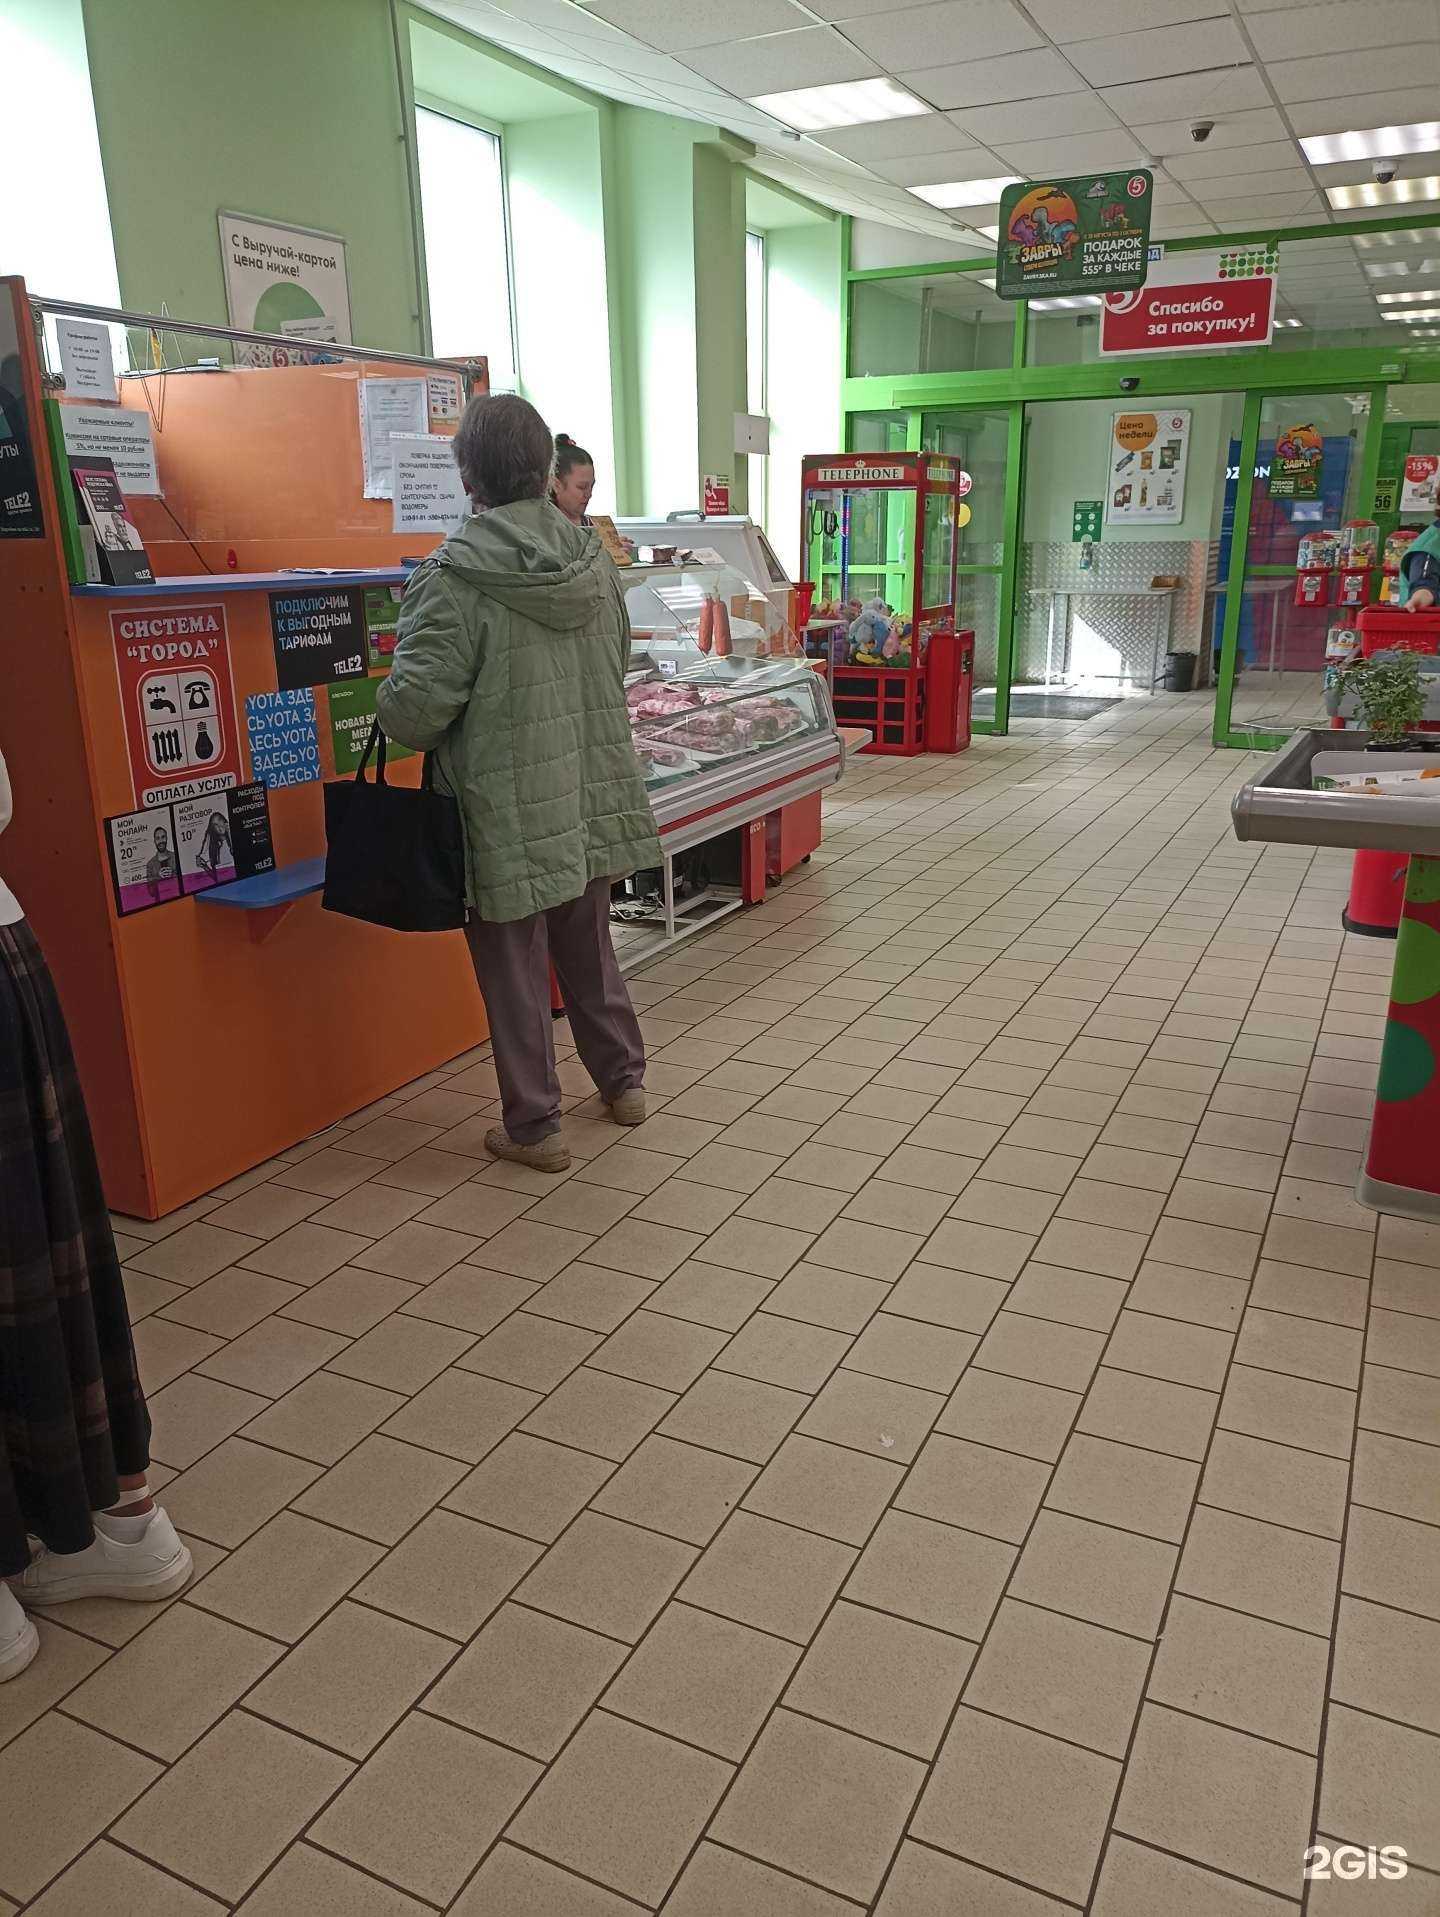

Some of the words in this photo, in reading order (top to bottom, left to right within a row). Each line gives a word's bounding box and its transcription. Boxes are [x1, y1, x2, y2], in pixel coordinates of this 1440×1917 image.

[231, 234, 240, 247] С
[243, 236, 336, 270] Выручай-картой
[1083, 237, 1142, 254] ПОДАРОК
[1021, 244, 1062, 263] ЗАВРЫ
[1083, 253, 1094, 264] ЗА
[1097, 250, 1142, 262] КАЖДЫЕ
[234, 253, 263, 269] цена
[267, 261, 300, 277] ниже!
[1106, 264, 1112, 273] В
[1115, 261, 1141, 272] ЧЕКЕ
[1149, 296, 1224, 317] Спасибо
[1148, 324, 1167, 335] за
[1171, 312, 1256, 335] покупку!
[1120, 421, 1144, 430] Цена
[1119, 431, 1153, 440] недели
[822, 468, 900, 480] TELEPHONE
[4, 491, 31, 510] TELE2
[1375, 495, 1392, 509] 56
[276, 595, 349, 615] ПОДКЛЮЧИМ
[120, 615, 219, 639] СИСТЕМА
[278, 619, 286, 632] К
[288, 612, 352, 632] ВЫГОДНЫМ
[279, 632, 332, 651] ТАРИФАМ
[333, 654, 363, 675] TELE2
[335, 716, 364, 730] НОВАЯ
[281, 727, 315, 744] YOTA
[350, 741, 361, 752] ЗА
[253, 750, 298, 771] ЗДЕСЬ
[268, 767, 313, 788] ЗДЕСЬ
[146, 784, 195, 804] ОПЛАТА
[197, 775, 233, 793] УСЛУГ
[237, 786, 264, 797] РАСХОДЫ
[252, 793, 265, 801] ПОД
[178, 803, 194, 815] МОЙ
[179, 808, 213, 822] РАЗГОВОР
[232, 801, 265, 814] КОНТРОЛЕМ
[117, 818, 134, 829] МОЙ
[118, 825, 148, 838] ОНЛАЙН
[254, 857, 273, 870] TELE2
